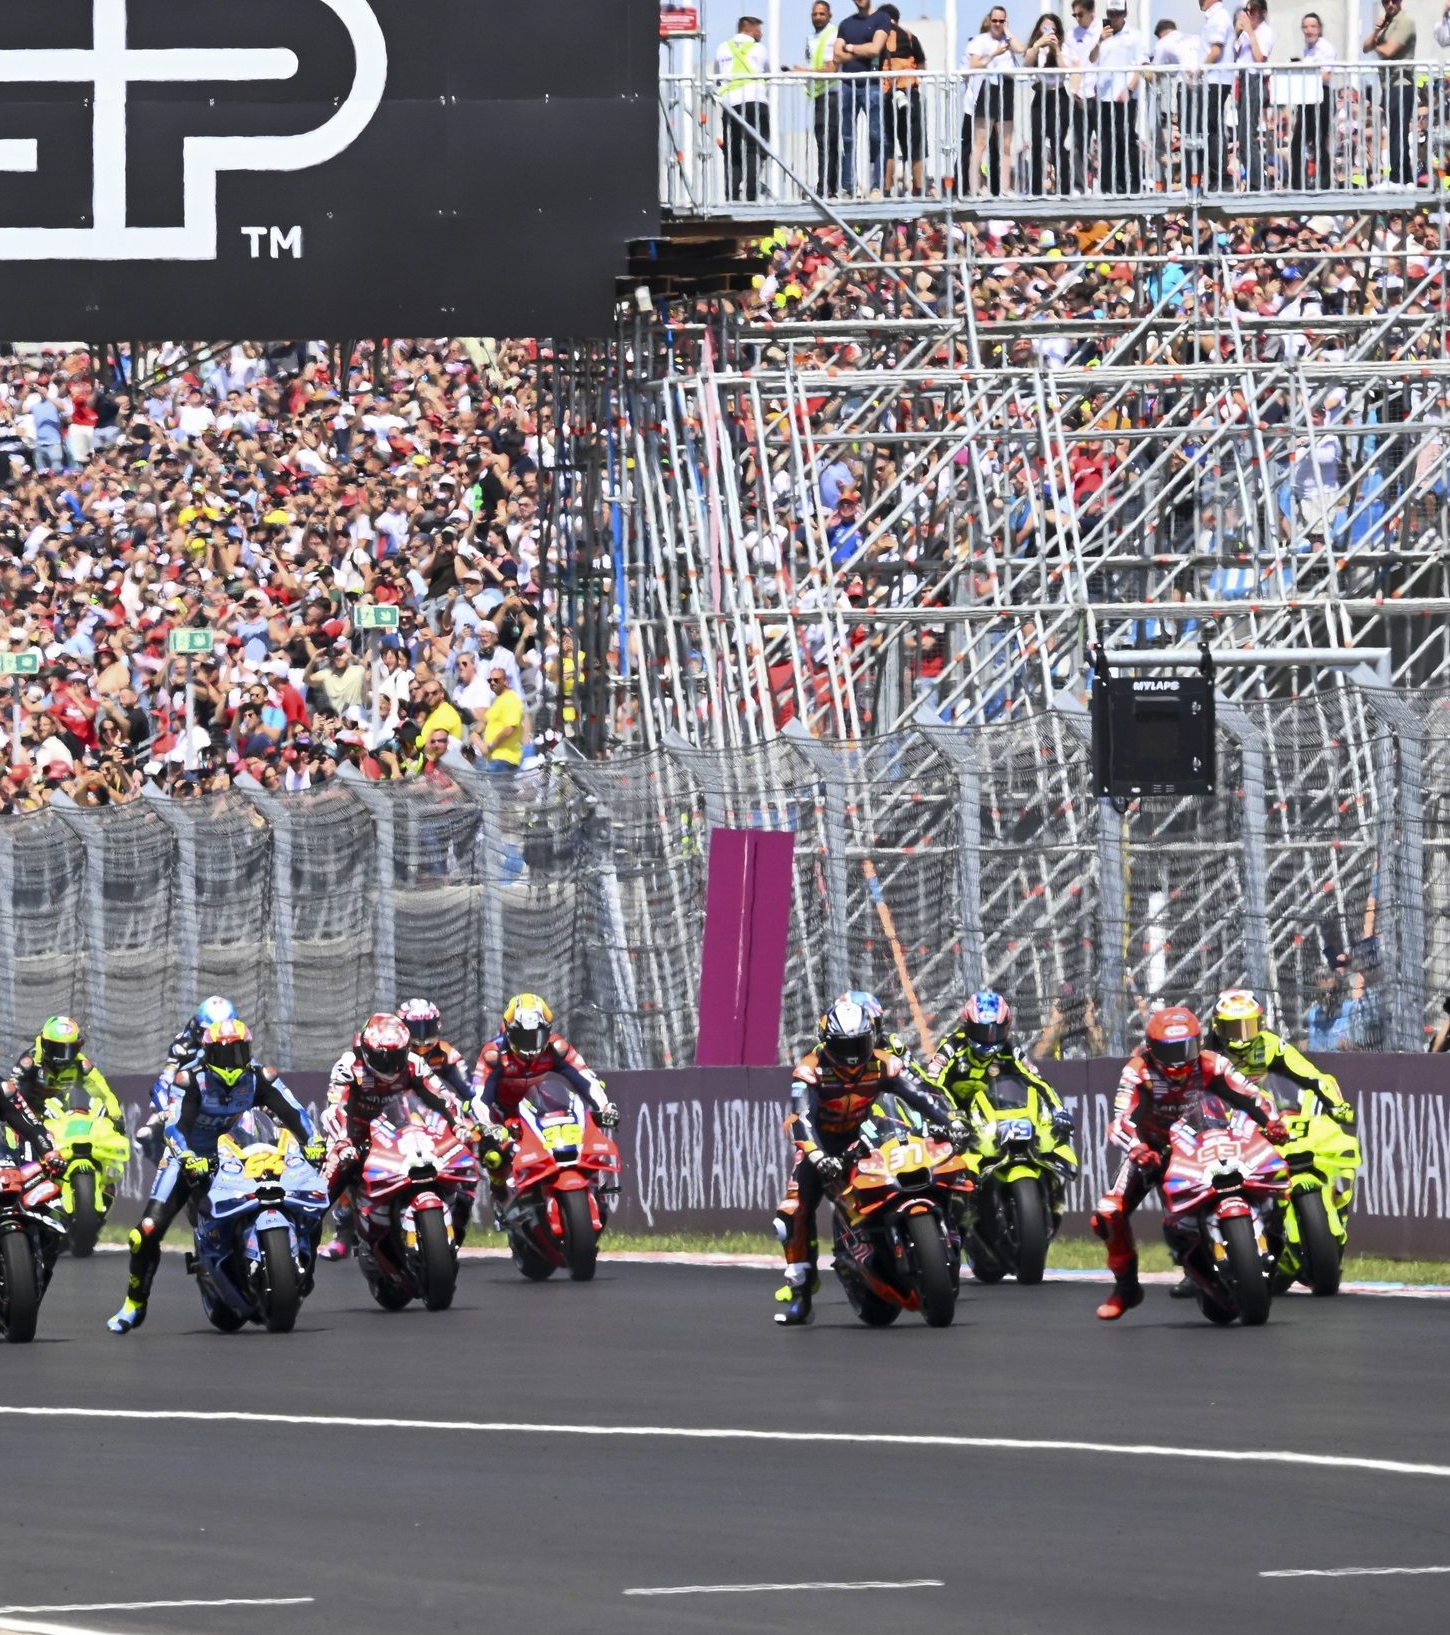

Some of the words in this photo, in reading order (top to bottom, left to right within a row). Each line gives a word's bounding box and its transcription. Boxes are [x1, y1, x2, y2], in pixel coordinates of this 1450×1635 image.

[1132, 681, 1181, 692] MYLAPS
[635, 1099, 706, 1227] QATAR
[889, 1143, 924, 1170] 37
[1197, 1140, 1242, 1163] 93
